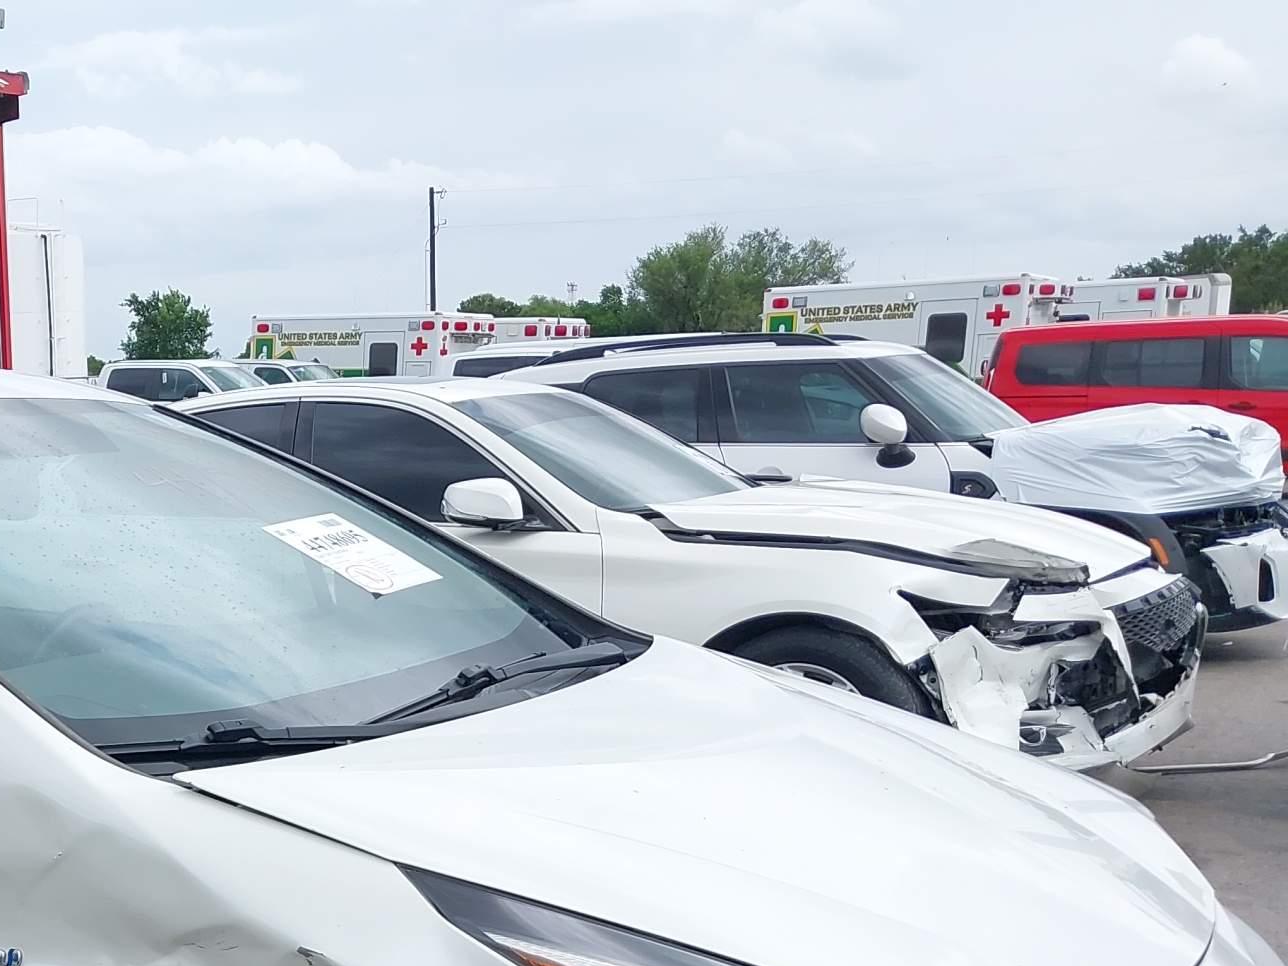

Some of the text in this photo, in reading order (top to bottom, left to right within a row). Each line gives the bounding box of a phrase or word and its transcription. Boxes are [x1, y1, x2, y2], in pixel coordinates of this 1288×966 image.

[800, 302, 919, 317] UNITED STATES ARMY
[804, 311, 914, 324] EMERGENCY MEDICAL SERVICE
[278, 331, 363, 341] UNITED STATES ARMY
